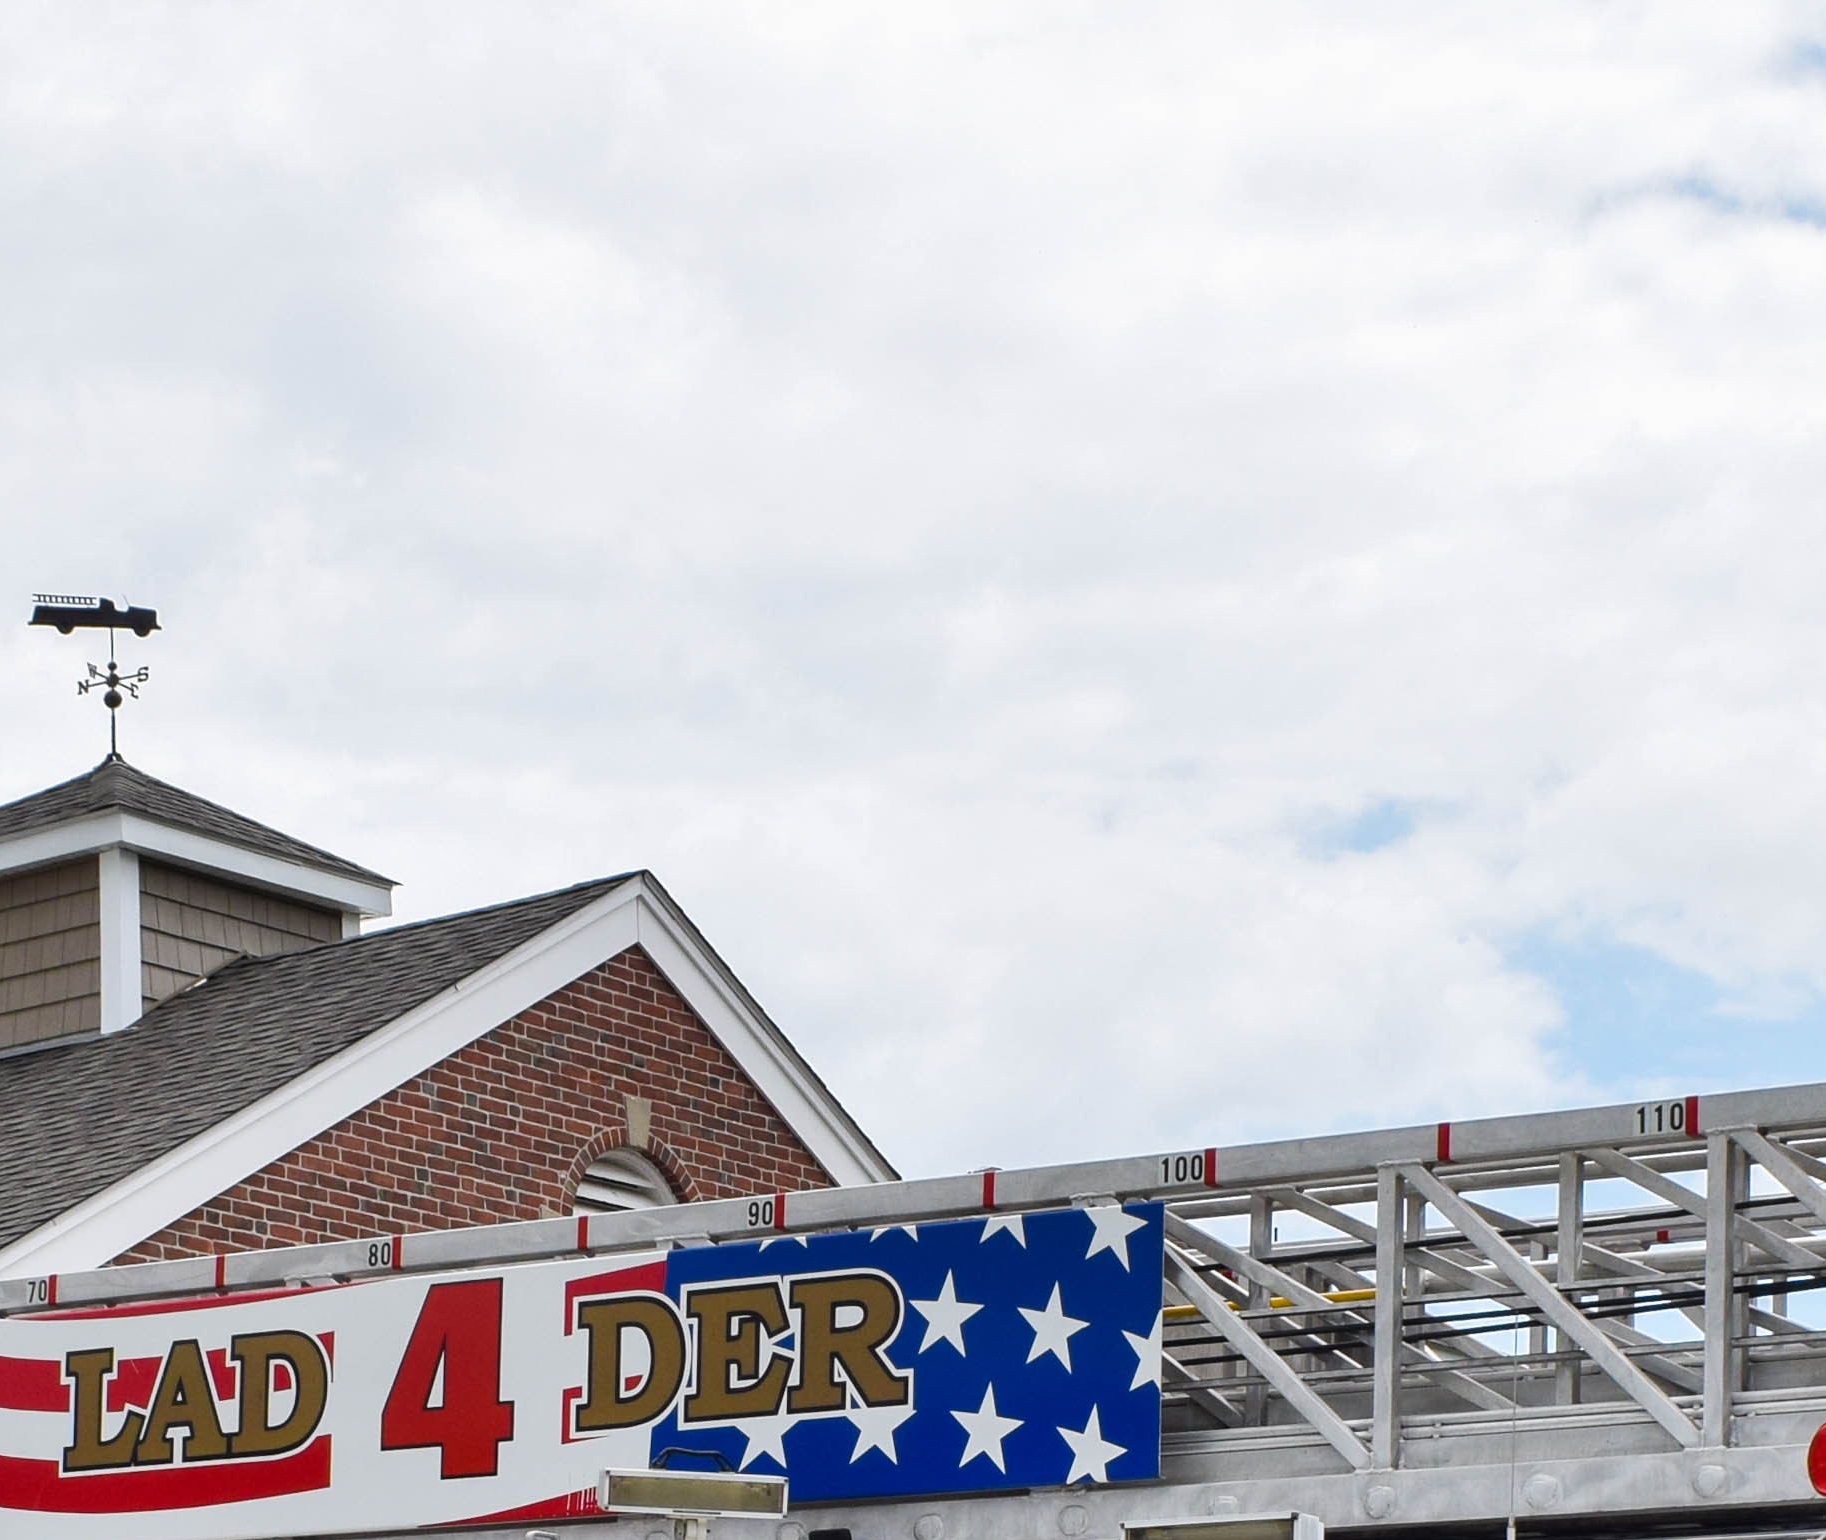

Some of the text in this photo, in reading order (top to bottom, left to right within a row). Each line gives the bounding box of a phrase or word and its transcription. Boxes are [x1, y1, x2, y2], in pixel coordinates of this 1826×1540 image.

[77, 679, 90, 695] N
[137, 666, 149, 682] S
[1635, 1102, 1684, 1134] 110
[1159, 1155, 1203, 1184] 100
[747, 1197, 774, 1227] 90
[367, 1241, 392, 1268] 80
[26, 1277, 49, 1304] 70
[62, 1270, 910, 1479] LAD 4 DER
